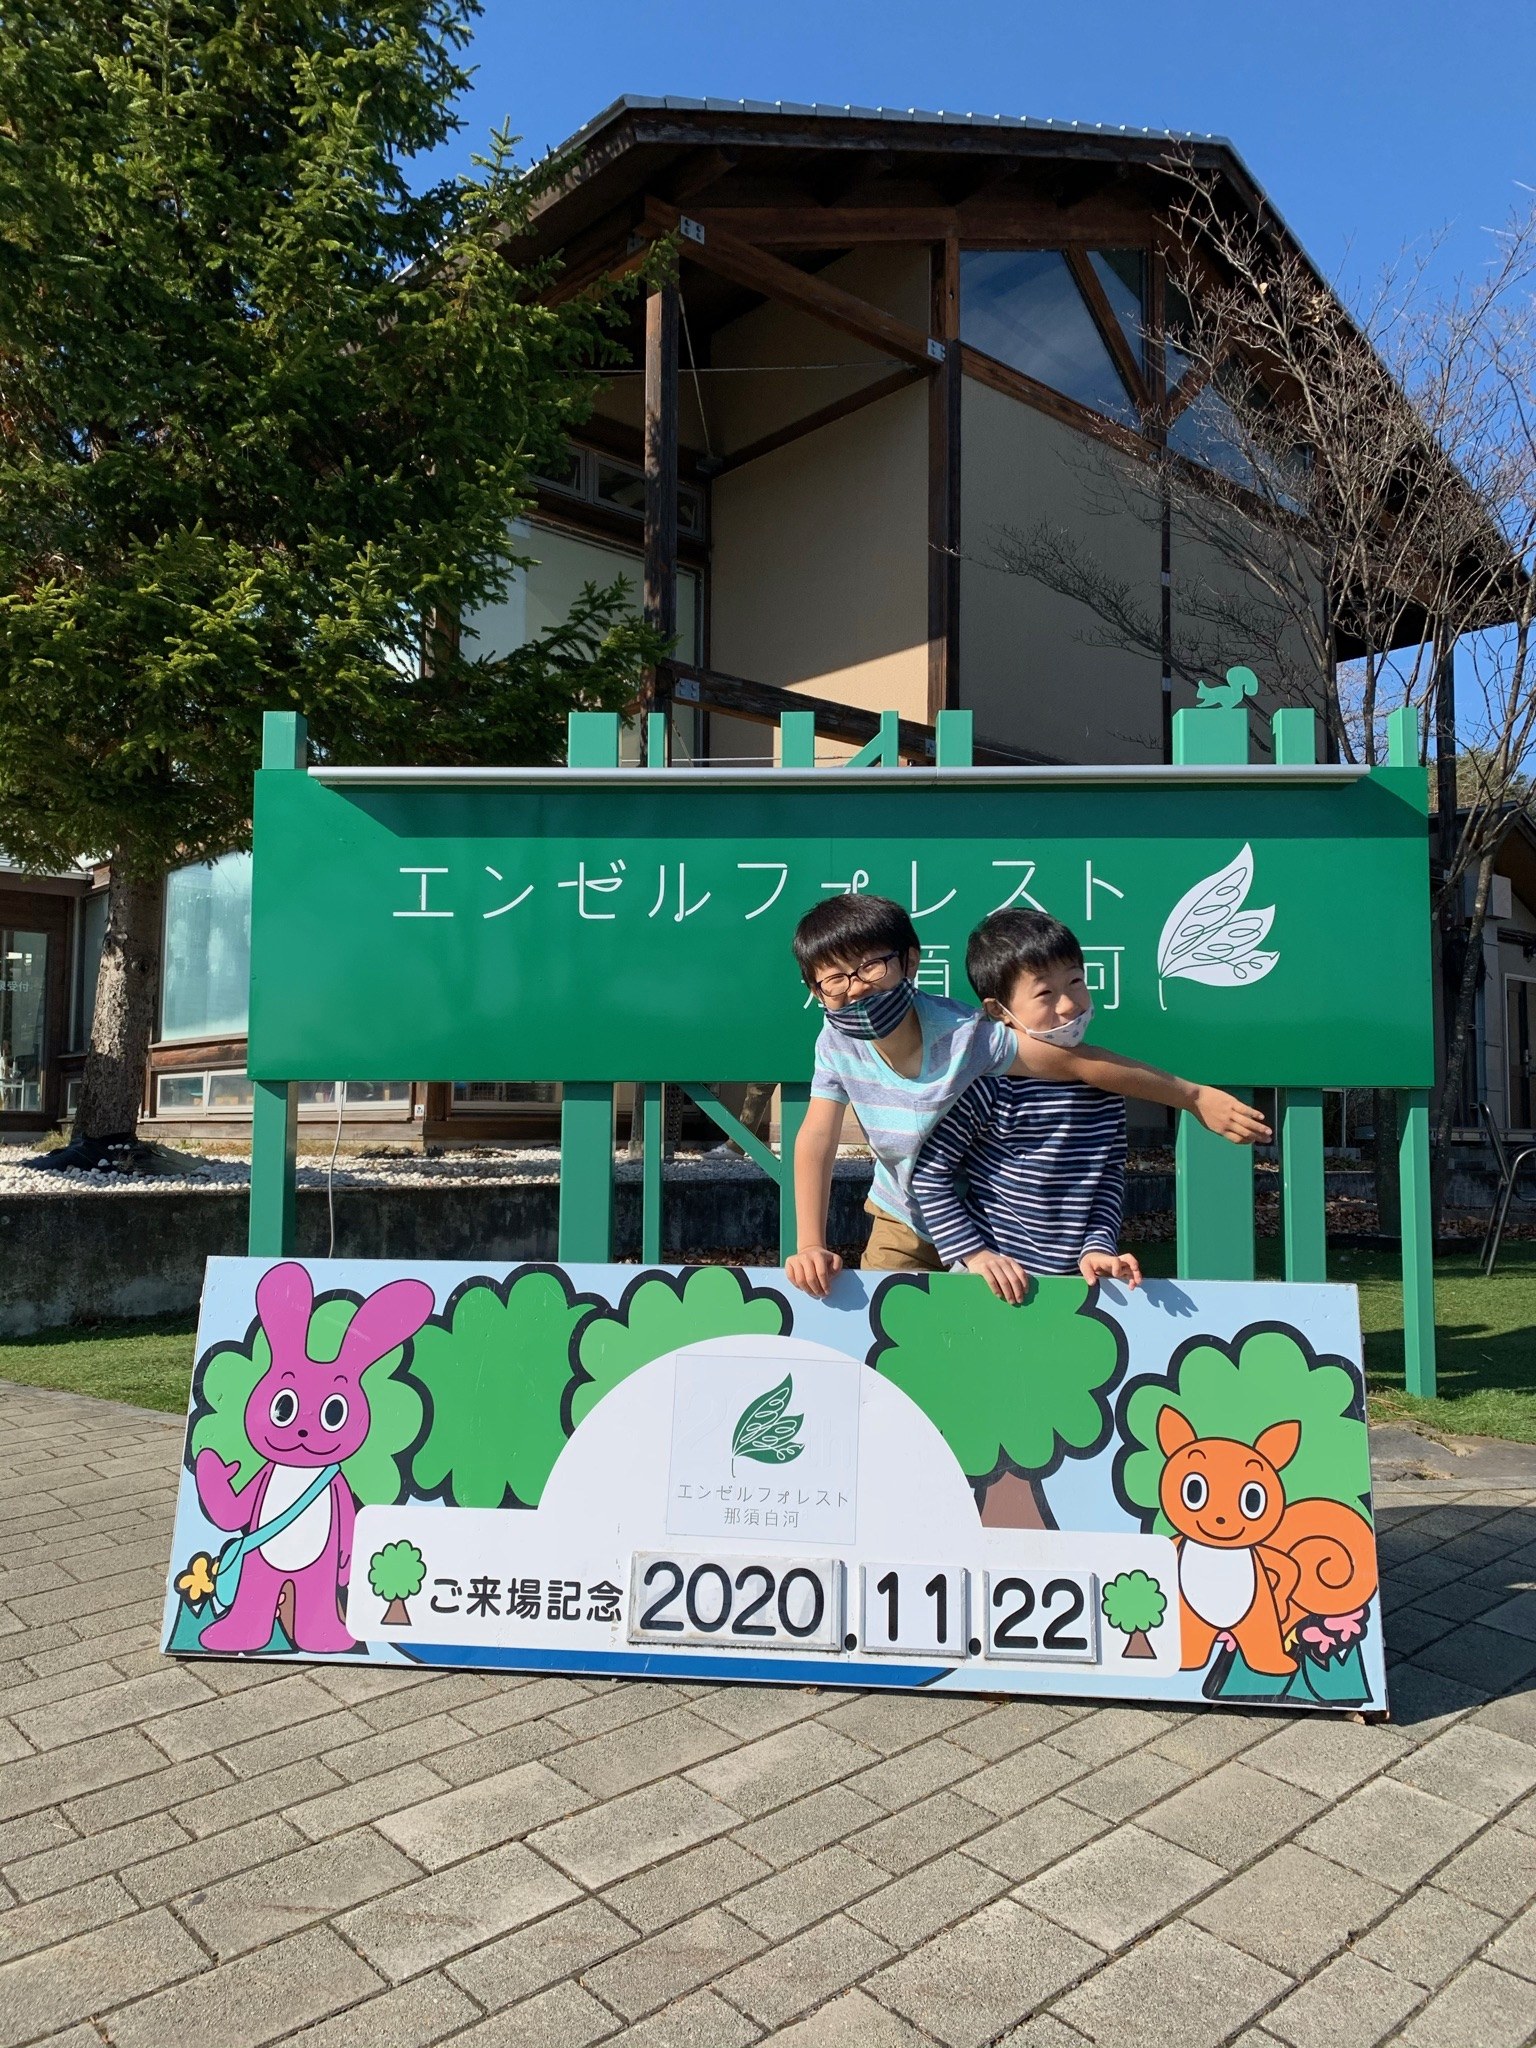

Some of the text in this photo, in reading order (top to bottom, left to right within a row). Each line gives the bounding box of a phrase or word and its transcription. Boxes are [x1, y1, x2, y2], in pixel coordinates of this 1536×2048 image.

[677, 1484, 848, 1507] エンゼルフォレスト
[724, 1507, 800, 1528] 那須白河
[430, 1575, 624, 1622] ご来場記念
